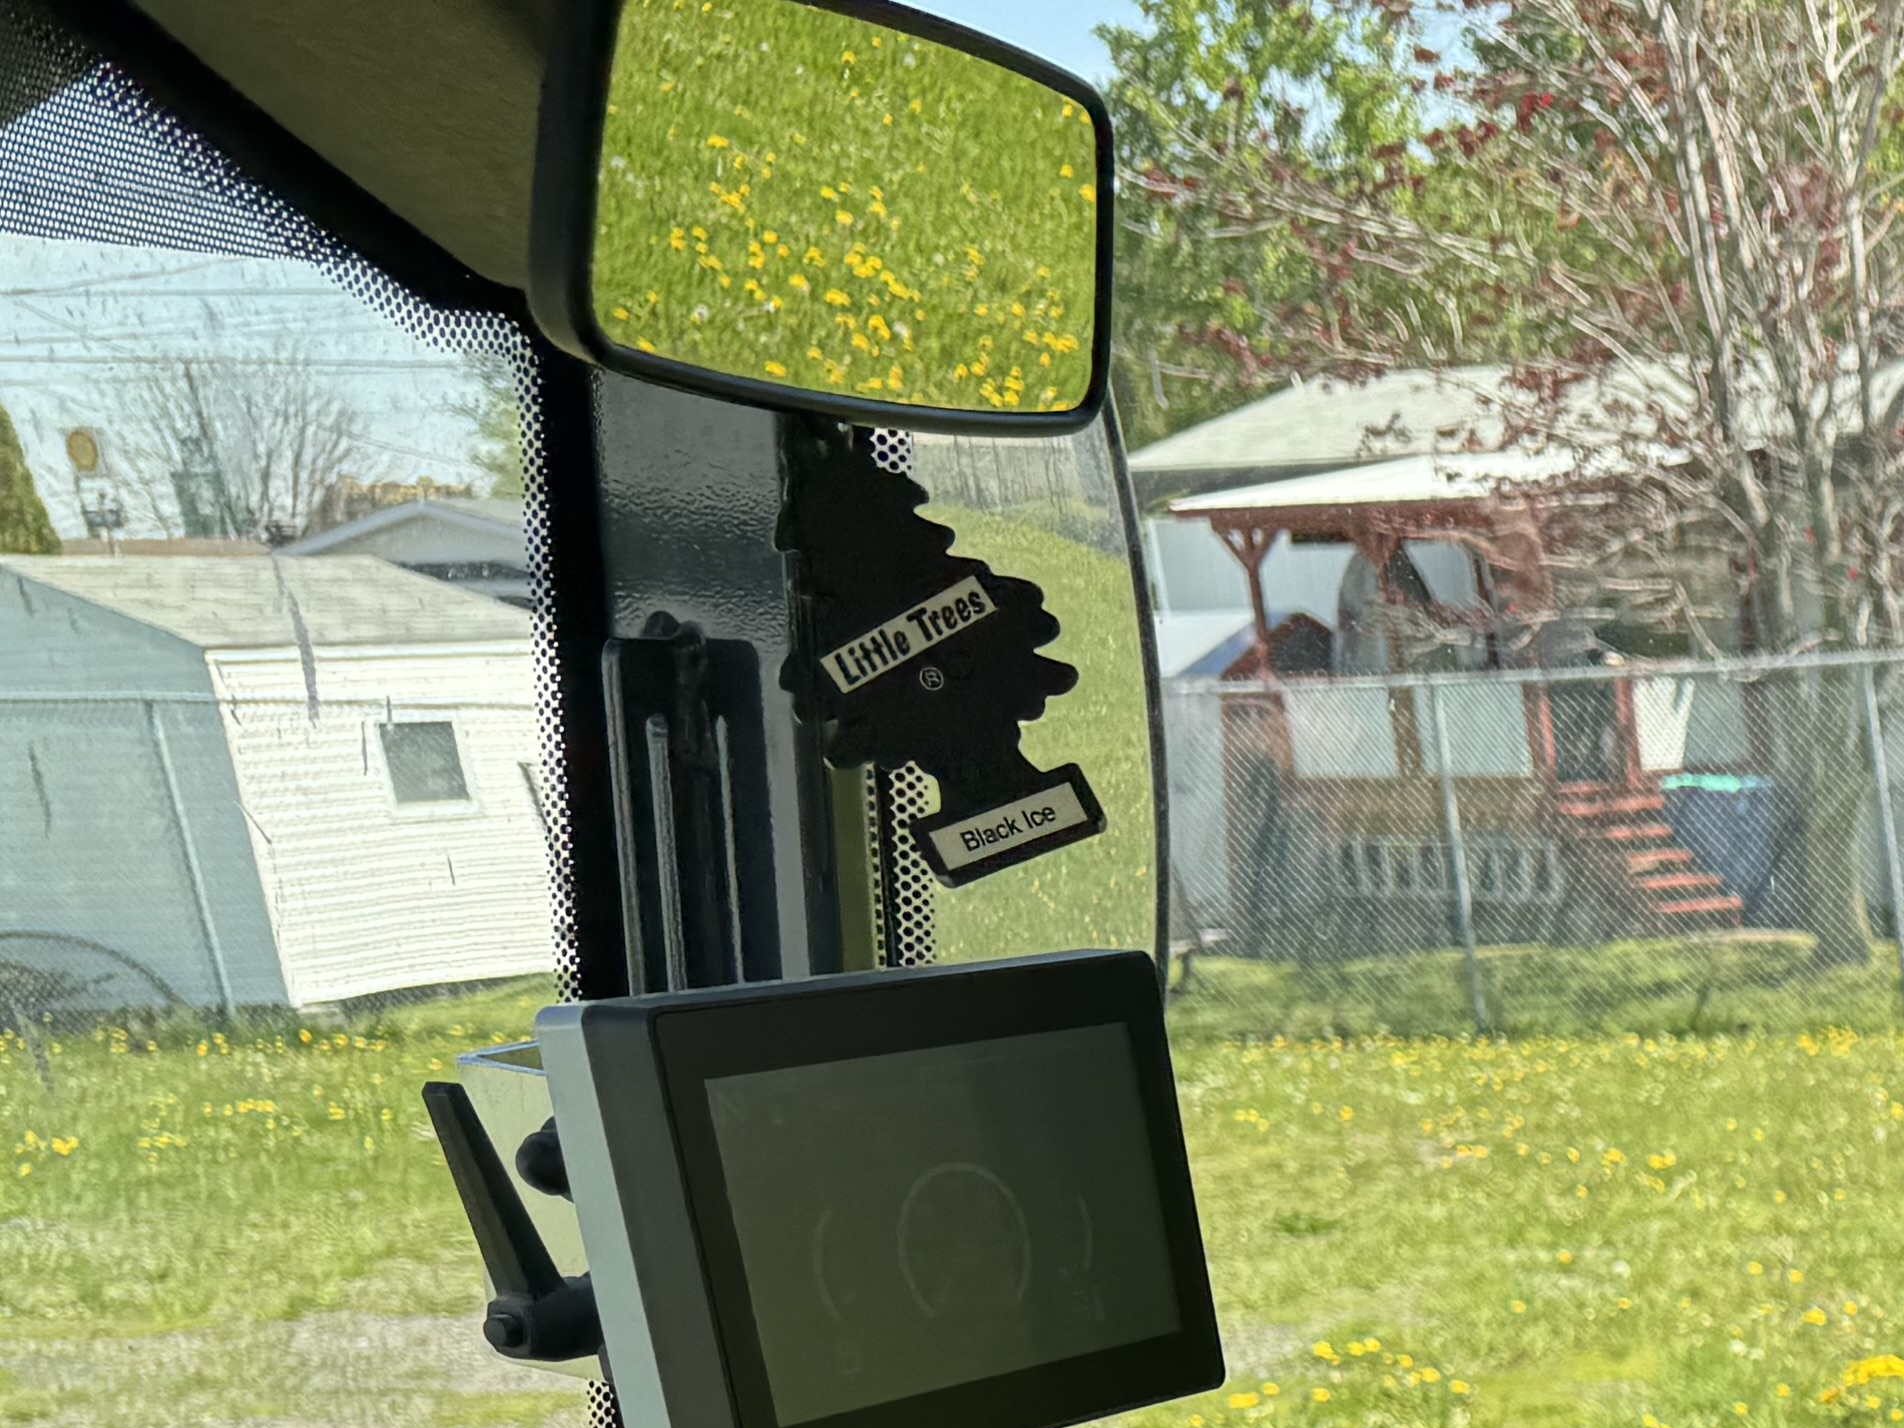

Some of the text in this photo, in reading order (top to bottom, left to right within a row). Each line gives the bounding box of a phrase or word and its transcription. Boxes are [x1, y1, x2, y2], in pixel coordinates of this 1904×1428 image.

[834, 590, 986, 686] Little Trees
[960, 802, 1056, 852] Black Ice
